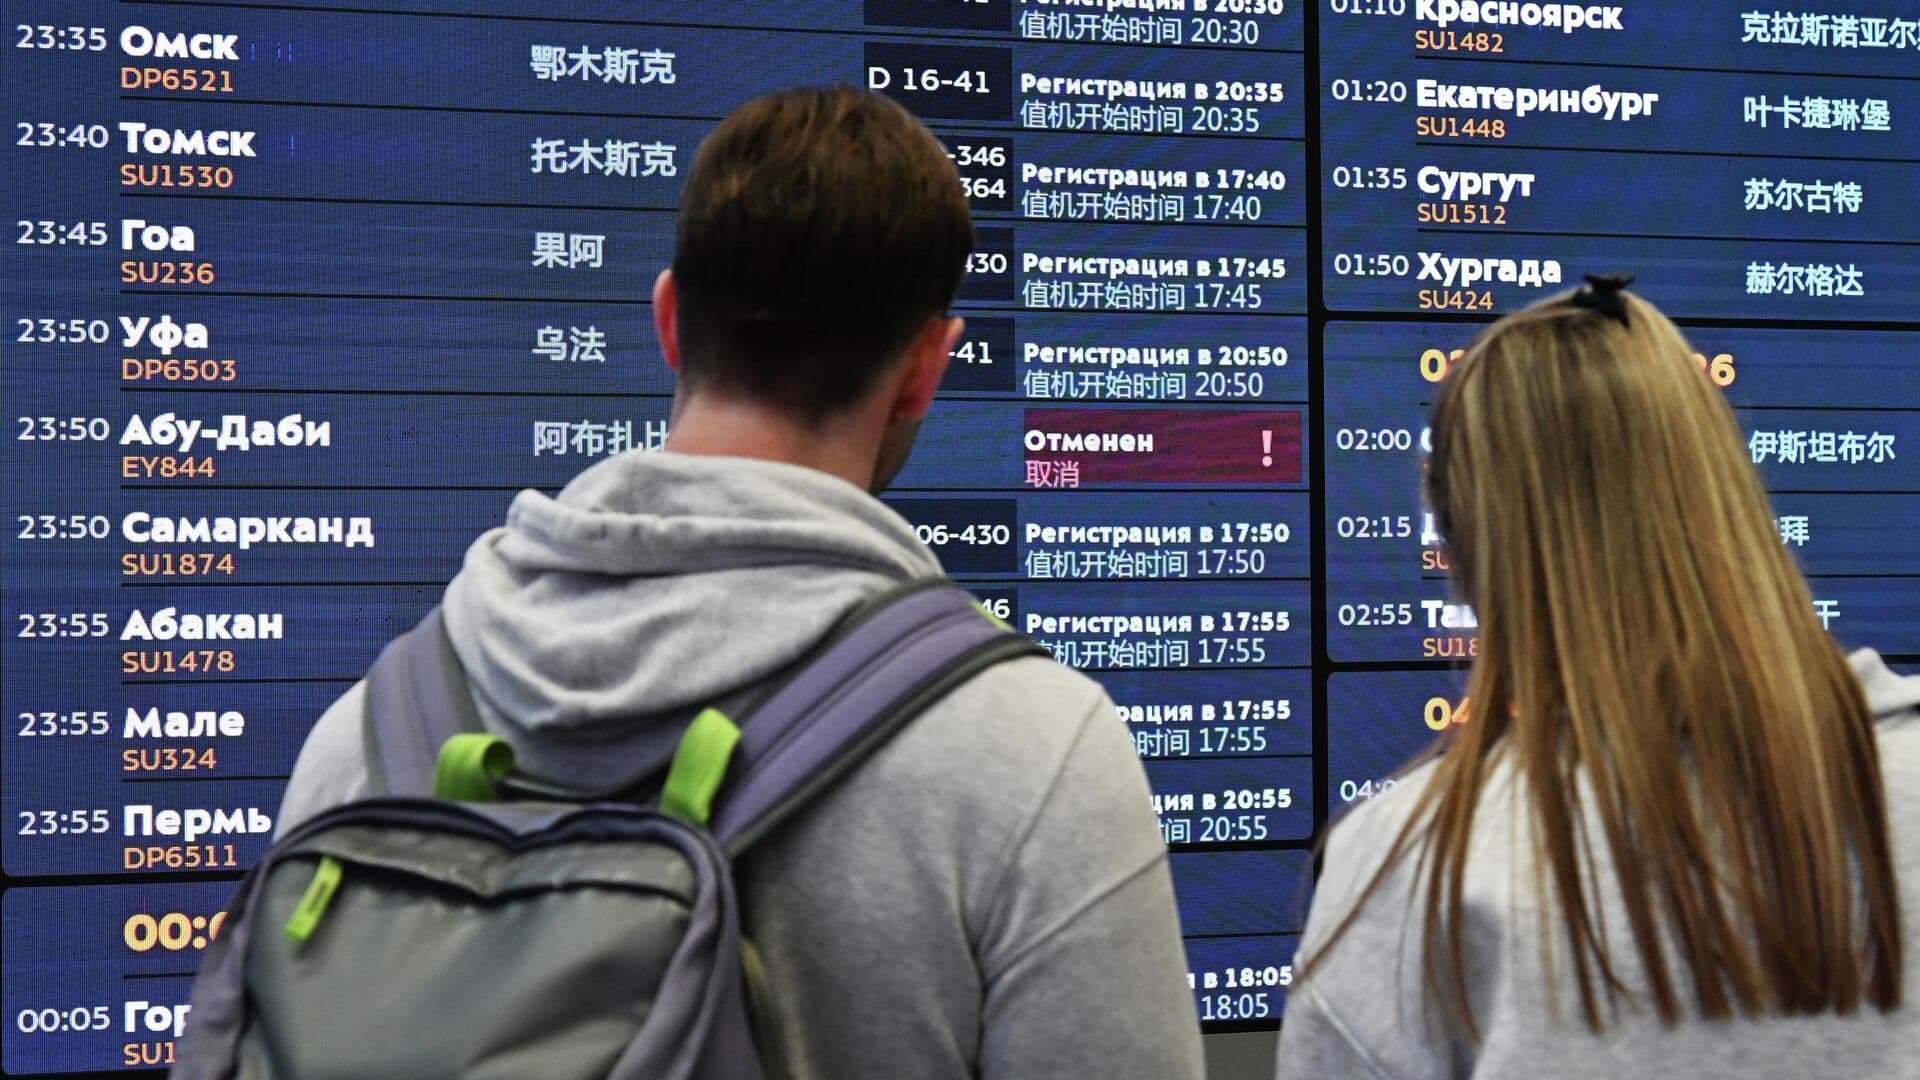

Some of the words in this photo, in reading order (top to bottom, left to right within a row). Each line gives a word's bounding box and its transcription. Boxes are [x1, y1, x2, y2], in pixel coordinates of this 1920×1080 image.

[1330, 0, 1406, 15] 01:10
[1415, 0, 1625, 34] Красноярск
[16, 24, 107, 51] 23:35
[1019, 9, 1182, 45] 值机开始时间
[1190, 17, 1259, 45] 20:30
[1739, 9, 1920, 50] 克拉斯诺亚尔
[120, 25, 240, 61] Омск
[1415, 29, 1504, 53] SU1482
[530, 45, 676, 85] 鄂木斯克
[121, 67, 234, 92] DP6521
[868, 66, 891, 89] D
[903, 68, 990, 93] 16-41
[1021, 72, 1186, 101] Регистрация
[1194, 83, 1209, 100] в
[1215, 80, 1284, 103] 20:35
[1331, 79, 1407, 103] 01:20
[1416, 78, 1659, 122] Екатеринбург
[1743, 94, 1891, 131] 叶卡捷琳堡
[1020, 99, 1183, 133] 值机开始时间
[1191, 106, 1259, 133] 20:35
[1416, 116, 1506, 139] SU1448
[16, 122, 109, 149] 23:40
[119, 121, 257, 157] Томск
[530, 137, 677, 178] 托木斯克
[121, 163, 234, 188] SU1530
[1022, 162, 1188, 191] Регистрация
[1195, 171, 1210, 188] в
[1217, 168, 1286, 191] 17:40
[1332, 166, 1407, 189] 01:35
[1417, 165, 1536, 203] Сургут
[1021, 189, 1184, 222] 值机开始时间
[1193, 194, 1261, 221] 17:40
[1743, 177, 1863, 214] 苏尔古特
[1417, 200, 1508, 225] SU1512
[16, 220, 108, 246] 23:45
[121, 219, 195, 252] Гоа
[531, 231, 606, 269] 果阿
[121, 261, 215, 285] SU236
[1023, 252, 1189, 280] Регистрация
[1196, 260, 1212, 277] в
[1218, 257, 1286, 279] 17:45
[1334, 253, 1410, 276] 01:50
[1416, 252, 1562, 288] Хургада
[1746, 261, 1865, 297] 赫尔格达
[1022, 279, 1185, 311] 值机开始时间
[1195, 283, 1262, 309] 17:45
[1418, 289, 1494, 311] SU424
[17, 318, 110, 344] 23:50
[118, 314, 209, 356] Уфа
[532, 325, 607, 363] 乌法
[1024, 342, 1190, 369] Регистрация
[1197, 348, 1212, 366] в
[1218, 345, 1288, 367] 20:50
[122, 358, 237, 382] DP6503
[1023, 368, 1186, 400] 值机开始时间
[1195, 371, 1264, 397] 20:50
[17, 416, 110, 441] 23:50
[118, 412, 331, 453] Абу-Даби
[1024, 429, 1154, 453] Отменен
[1336, 428, 1412, 451] 02:00
[1748, 430, 1896, 464] 伊斯坦布尔
[122, 455, 217, 478] EY844
[1023, 458, 1082, 490] 取消
[17, 515, 111, 539] 23:50
[122, 511, 375, 550] Самарканд
[909, 522, 1011, 547] 06-430
[1025, 523, 1192, 548] Регистрация
[1199, 526, 1214, 543] в
[1221, 522, 1290, 543] 17:50
[1337, 516, 1412, 538] 02:15
[122, 553, 235, 576] SU1874
[1025, 549, 1188, 578] 值机开始时间
[1197, 549, 1265, 574] 17:50
[17, 613, 109, 638] 23:55
[119, 606, 283, 641] Абакан
[1026, 613, 1192, 638] Регистрация
[1200, 615, 1215, 632] в
[1222, 611, 1290, 632] 17:55
[1338, 603, 1413, 626] 02:55
[122, 650, 235, 673] SU1478
[1036, 637, 1189, 668] 机开始时间
[1198, 637, 1266, 663] 17:55
[123, 706, 245, 739] Мале
[1201, 704, 1216, 721] в
[1222, 699, 1291, 721] 17:55
[18, 711, 110, 737] 23:55
[1129, 728, 1190, 757] 时间
[1199, 726, 1267, 752] 17:55
[123, 747, 217, 771] SU324
[1202, 793, 1217, 811] в
[1223, 788, 1292, 810] 20:55
[18, 809, 110, 836] 23:55
[123, 804, 272, 842] Пермь
[1199, 815, 1268, 842] 20:55
[124, 844, 237, 870] DP6511
[1204, 972, 1219, 989] в
[1223, 963, 1293, 989] 18:05
[17, 1006, 111, 1033] 00:05
[1201, 992, 1269, 1020] 18:05
